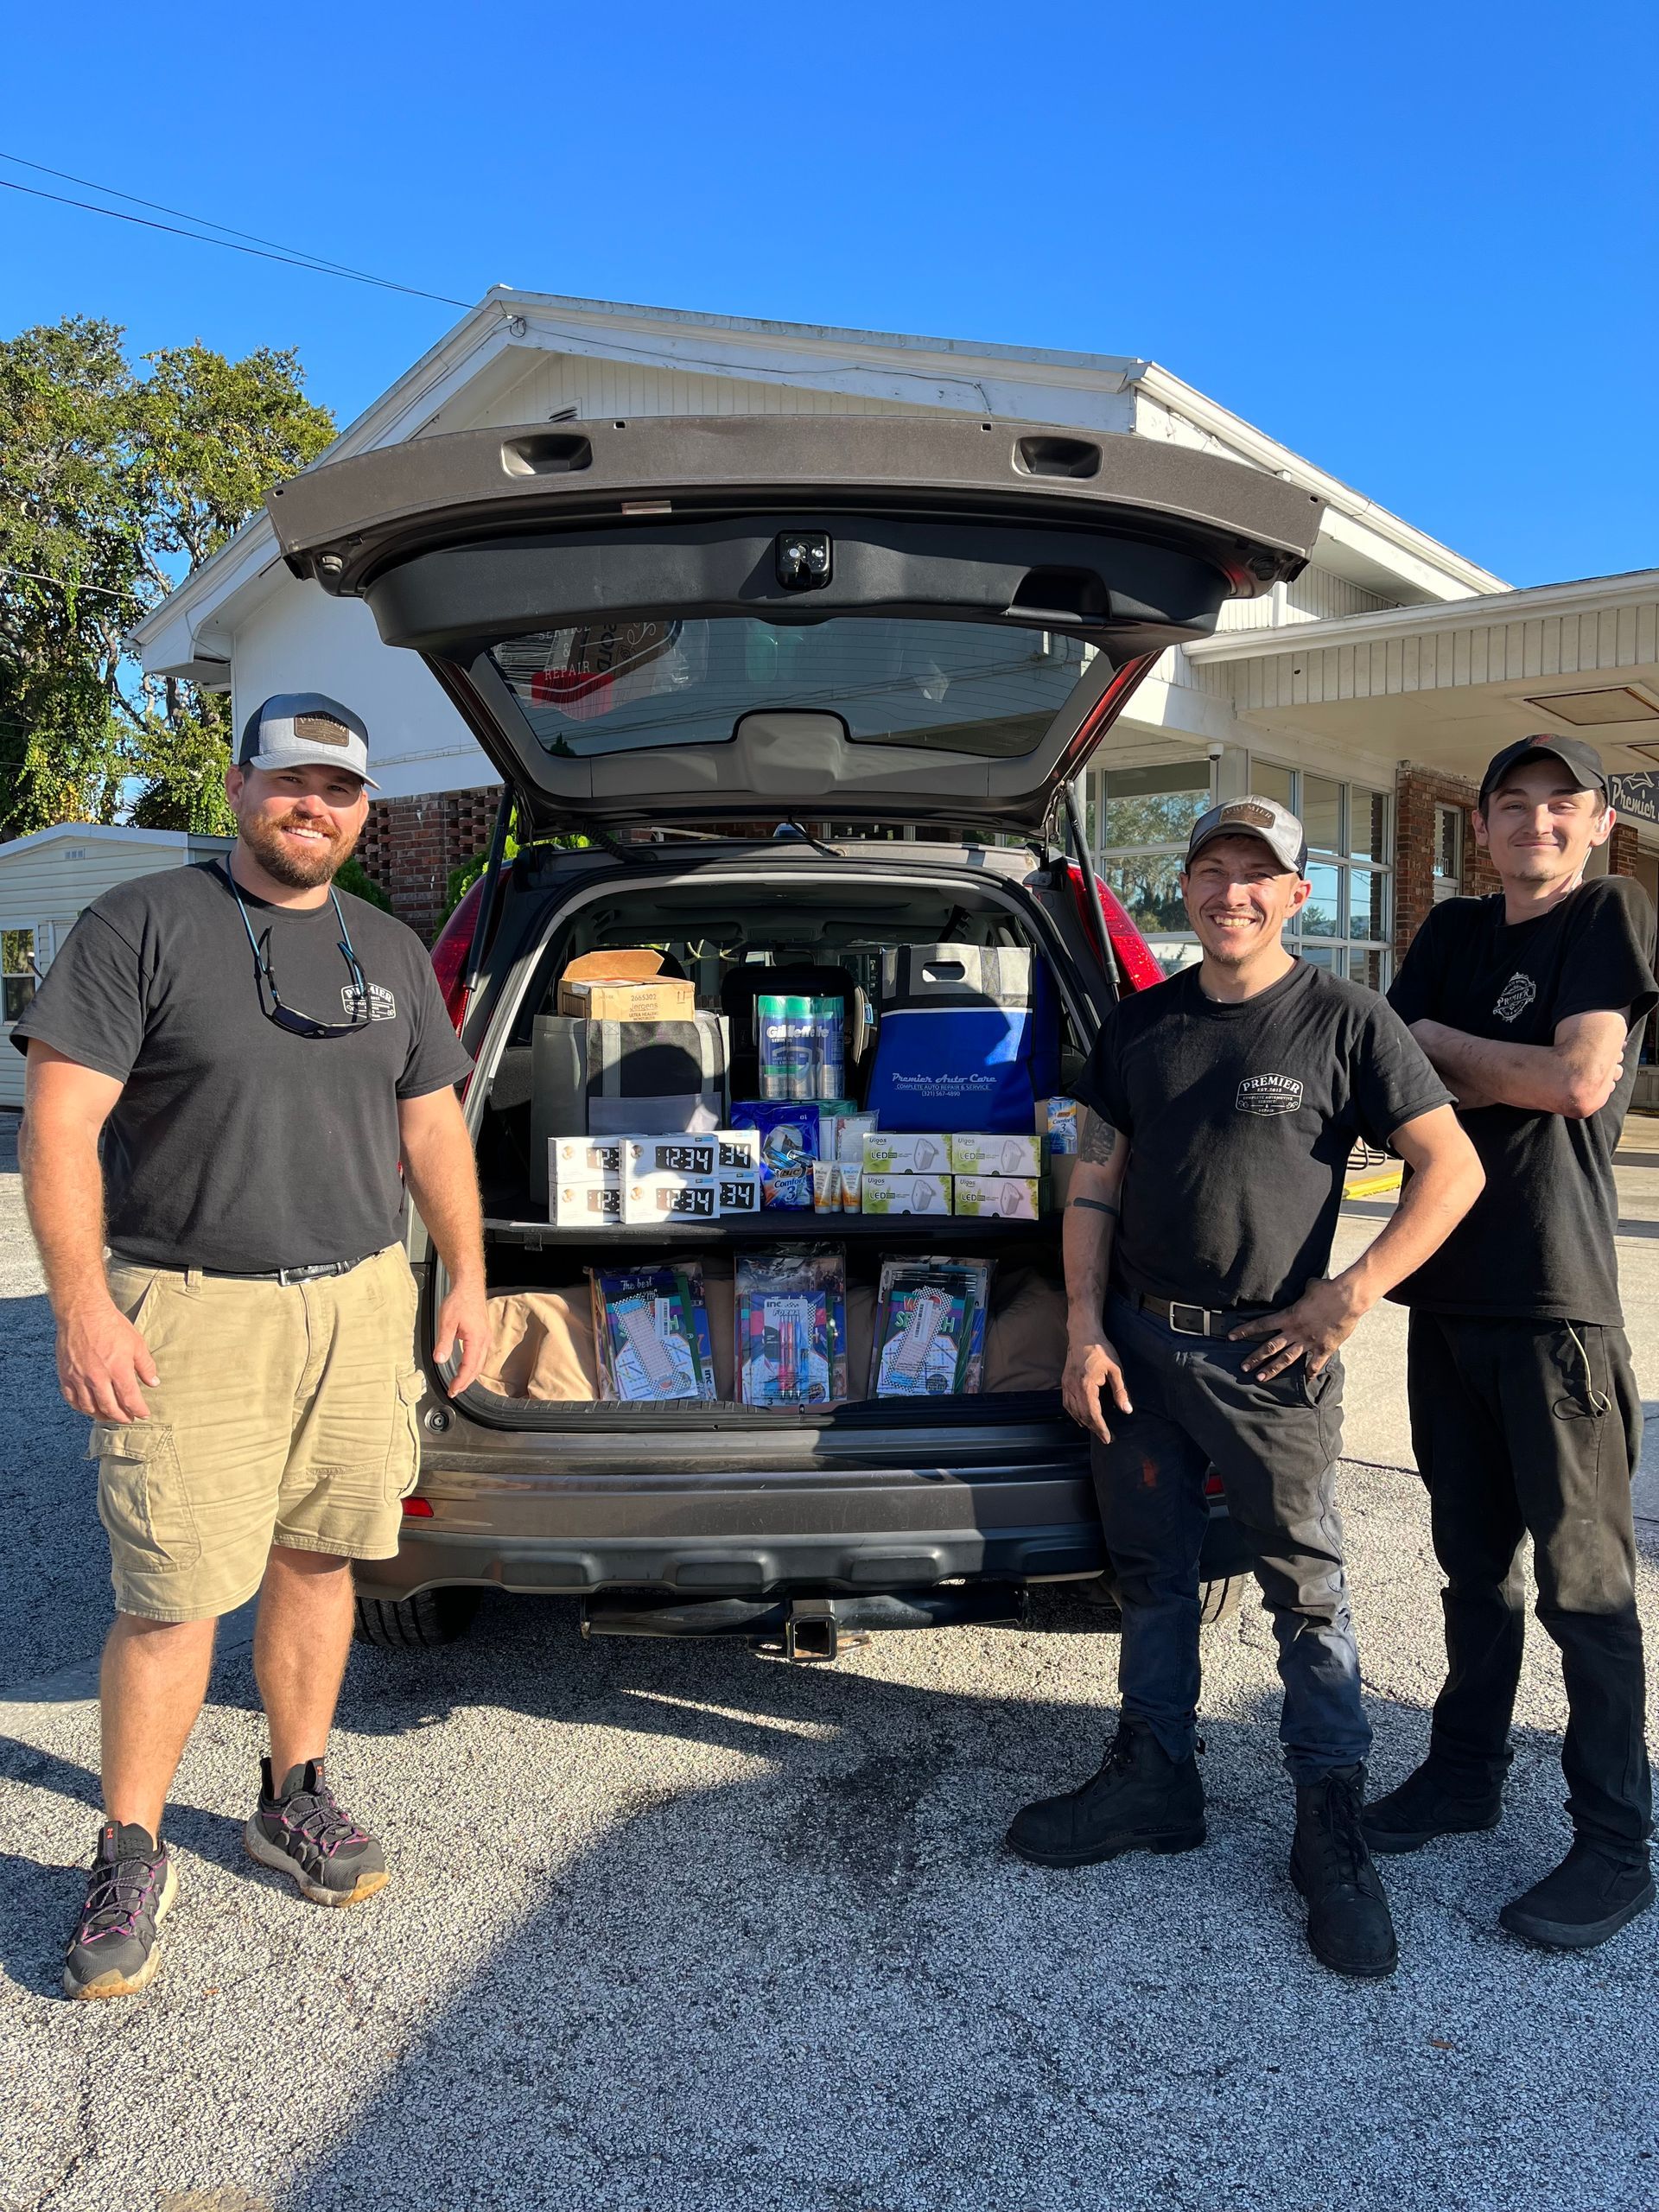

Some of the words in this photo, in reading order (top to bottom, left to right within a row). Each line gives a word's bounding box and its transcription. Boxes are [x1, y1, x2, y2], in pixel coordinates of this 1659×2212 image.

[563, 642, 570, 658] &
[543, 661, 590, 681] REPAIR
[1611, 776, 1656, 819] Premier
[630, 1002, 658, 1011] Jergens
[893, 1072, 932, 1083] Premier
[935, 1073, 968, 1083] Auto
[969, 1073, 997, 1083] Care
[1243, 1077, 1300, 1094] PREMIER
[1059, 1123, 1066, 1133] 3
[665, 1147, 709, 1171] 12:34
[774, 1176, 806, 1188] Comfort
[786, 1185, 796, 1200] 3
[665, 1189, 709, 1212] 12:34
[620, 1280, 635, 1291] The
[637, 1276, 655, 1287] best
